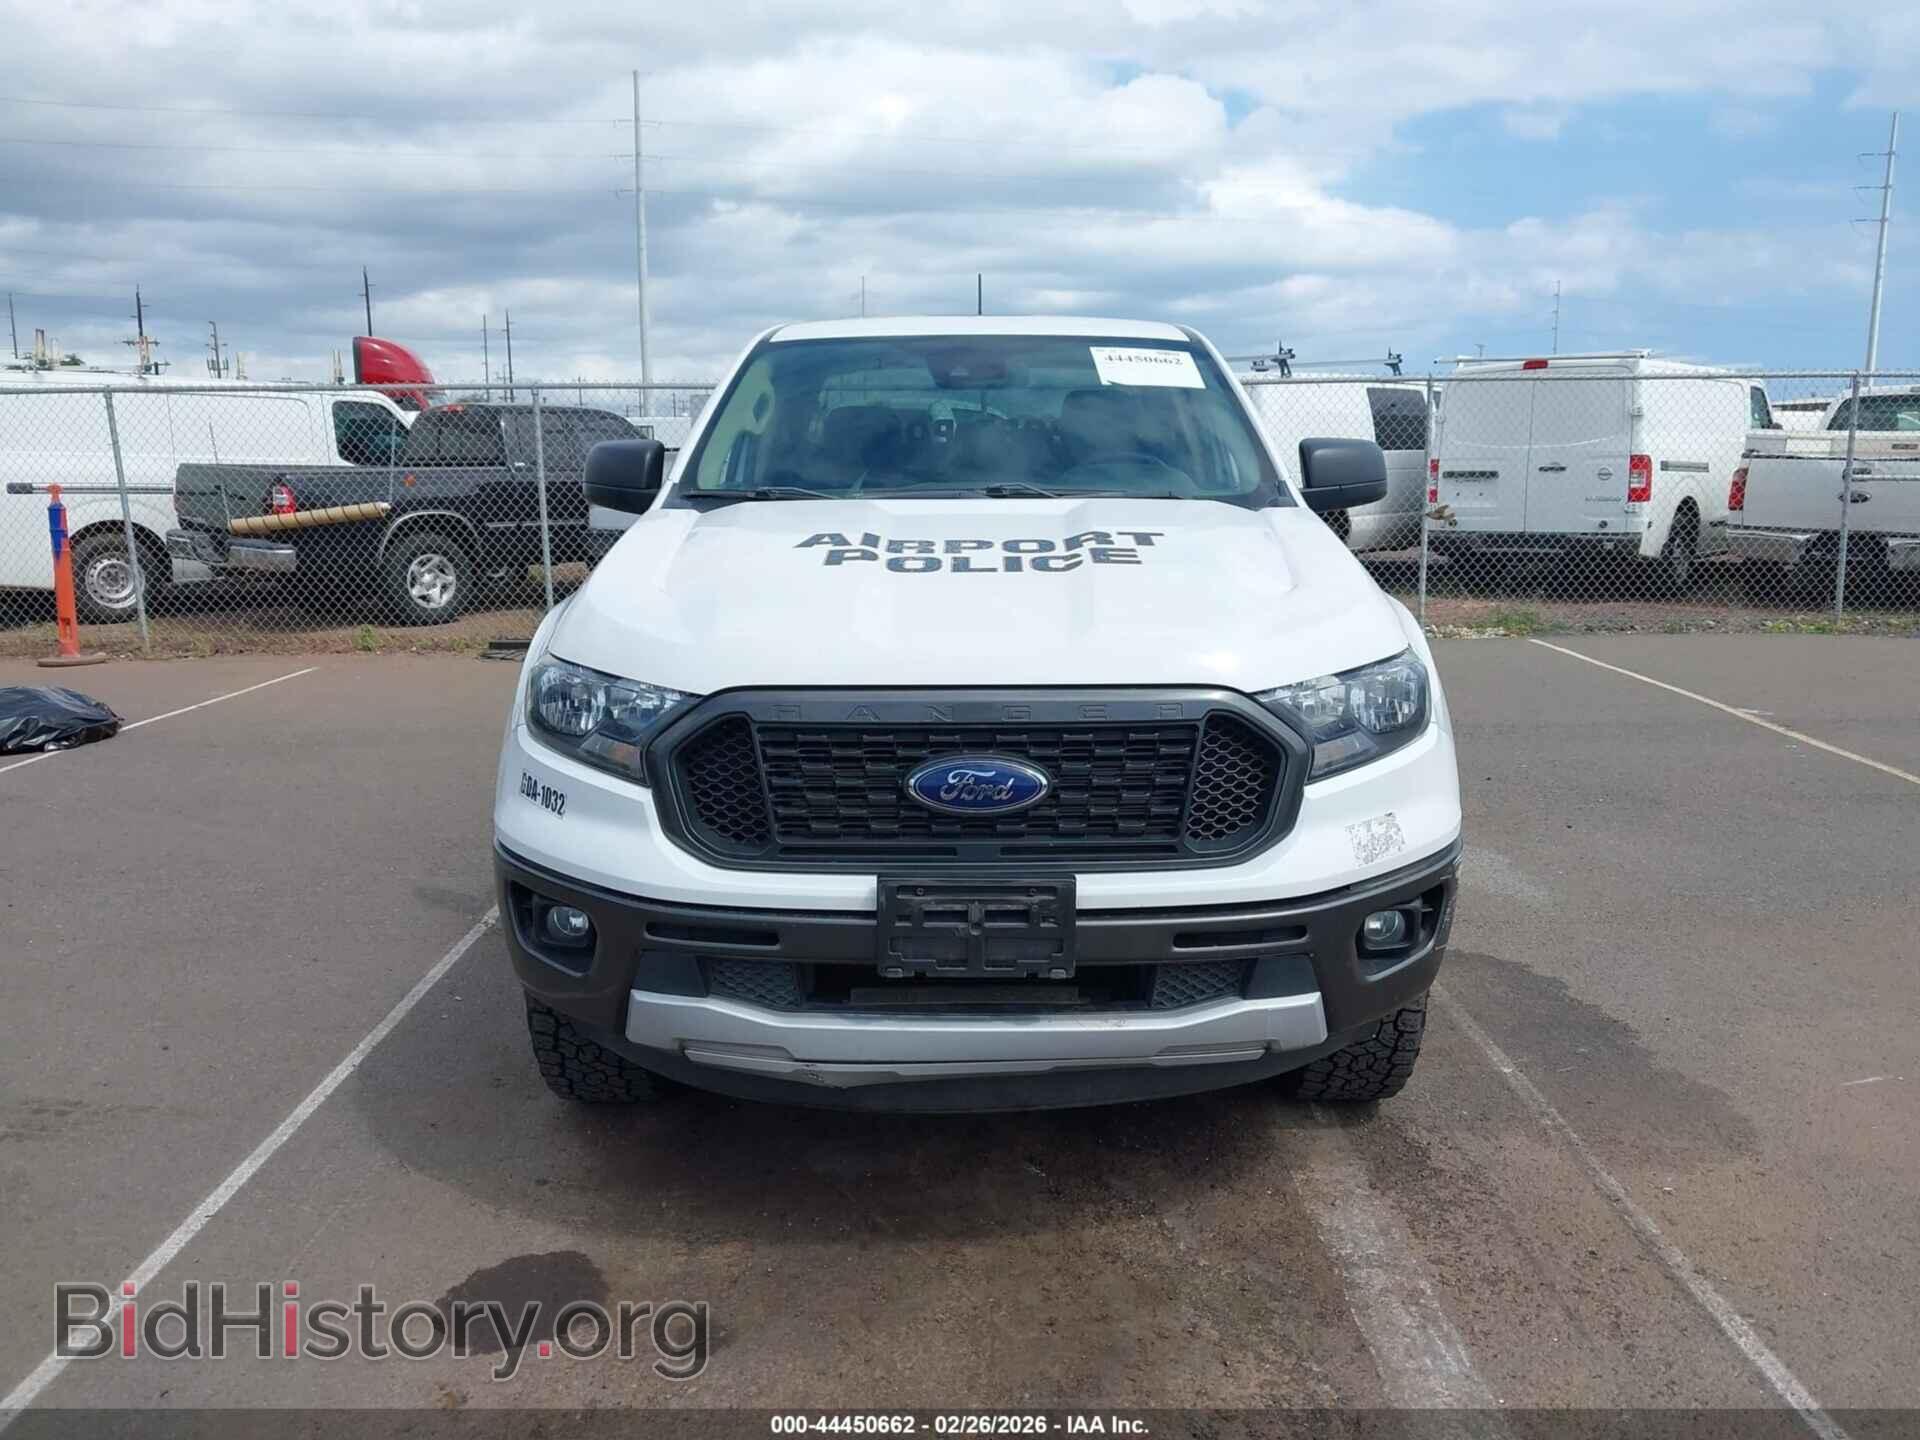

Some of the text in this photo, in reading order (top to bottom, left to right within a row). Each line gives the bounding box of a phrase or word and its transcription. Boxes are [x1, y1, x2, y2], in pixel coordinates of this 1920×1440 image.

[793, 531, 1165, 553] AIRPORT
[823, 548, 1142, 573] POLICE
[771, 703, 1184, 721] RANGER
[520, 772, 566, 816] GDA-1032
[939, 768, 1015, 802] Ford
